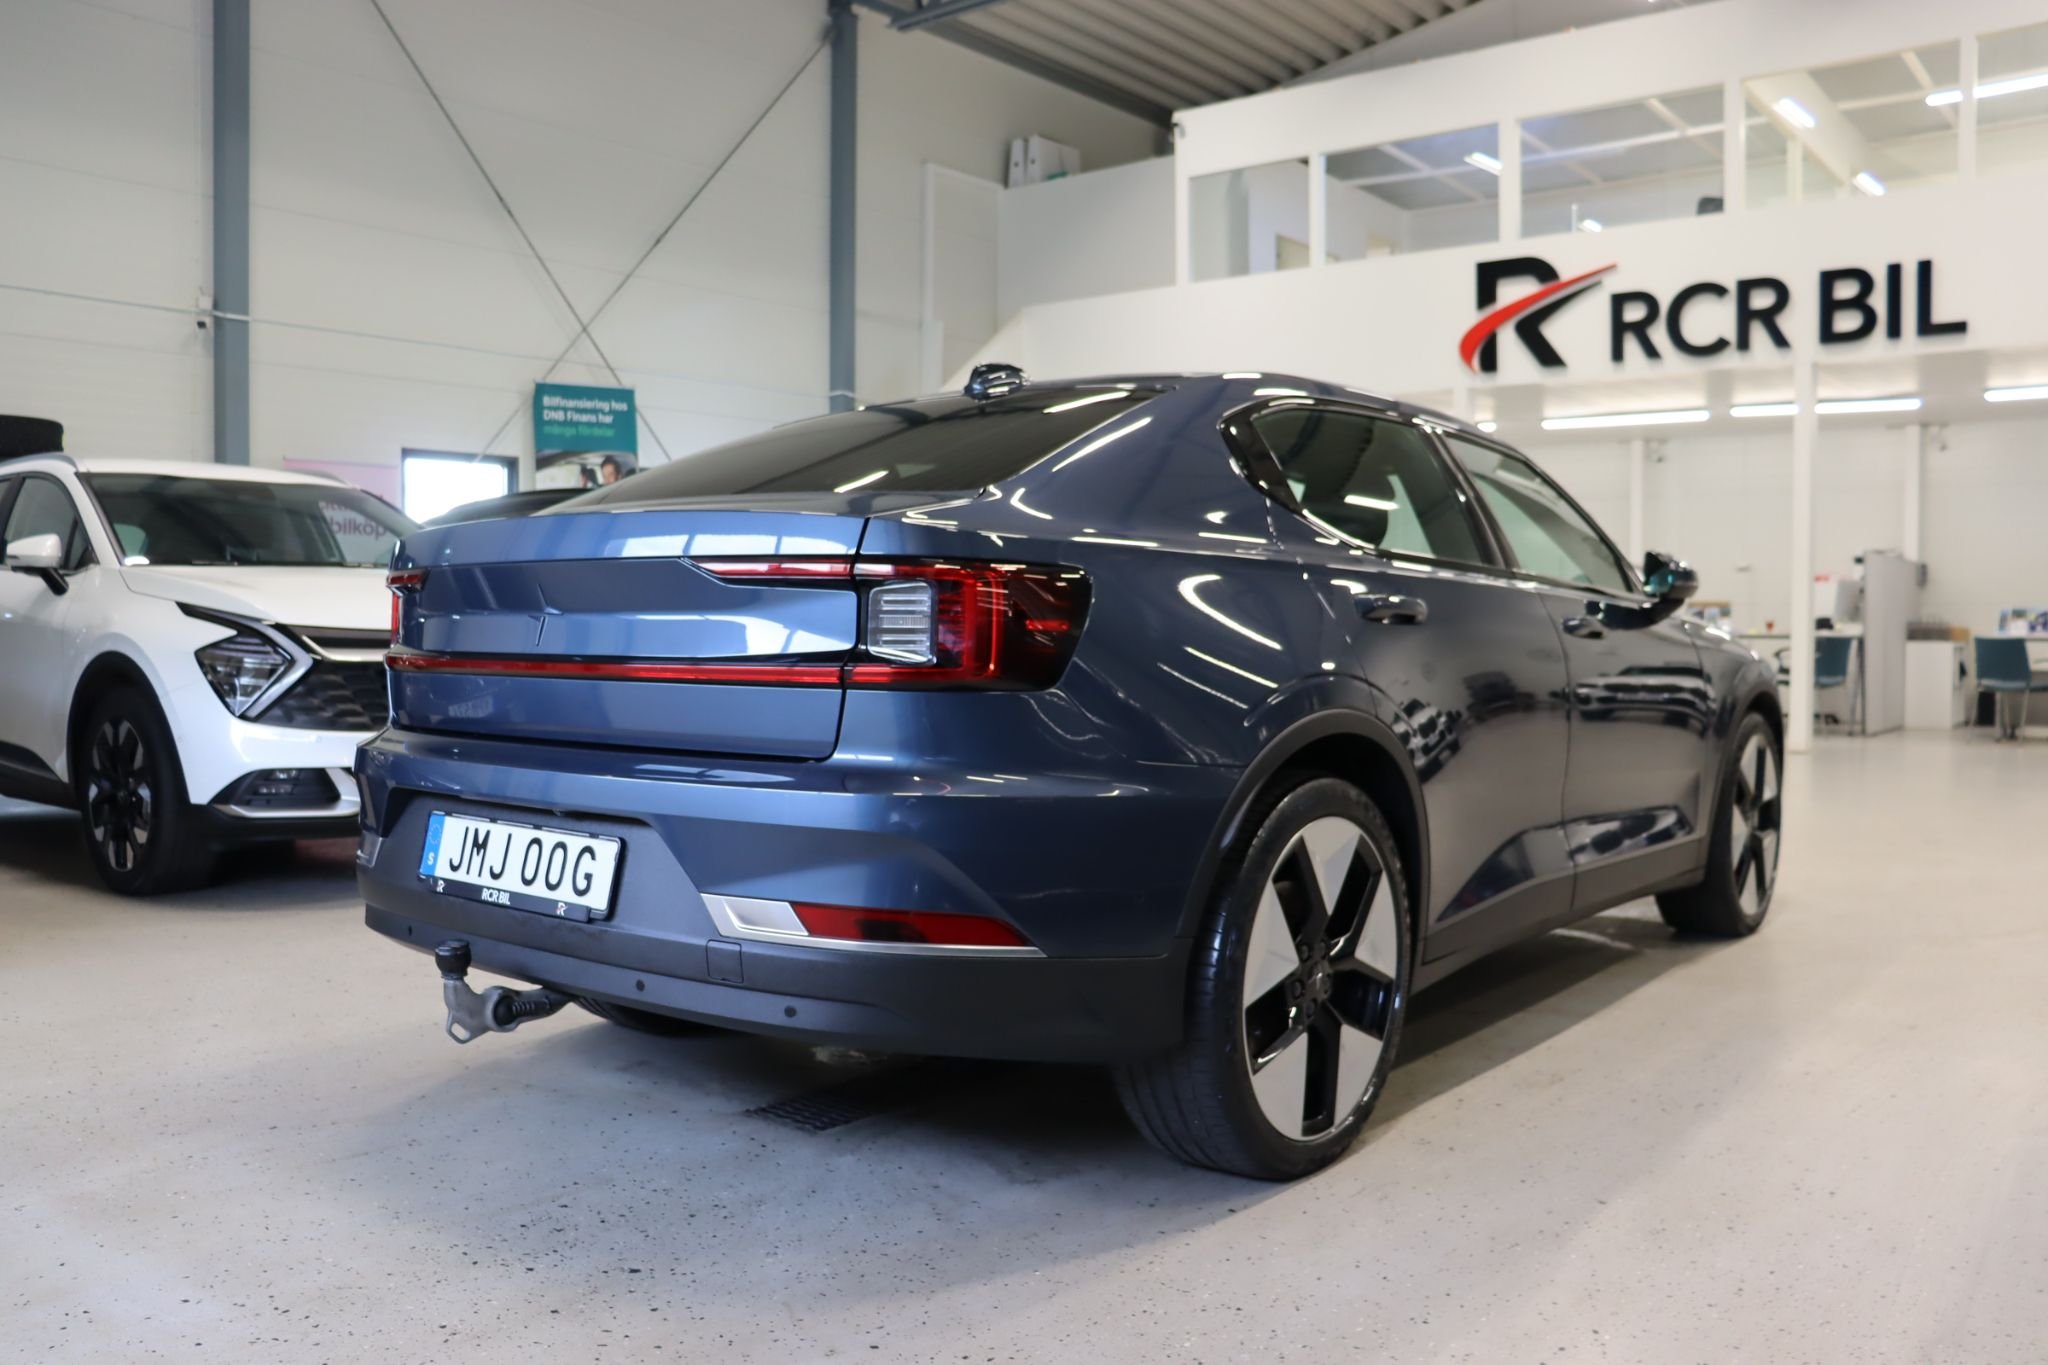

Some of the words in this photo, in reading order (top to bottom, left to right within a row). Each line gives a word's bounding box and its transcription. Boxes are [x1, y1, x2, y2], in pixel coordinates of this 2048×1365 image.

[1610, 277, 1792, 363] RCR
[1818, 259, 1968, 345] BIL
[543, 395, 610, 413] Bilfinansiering
[611, 400, 628, 412] hos
[543, 409, 565, 422] DNB
[567, 410, 597, 423] Finans
[598, 412, 614, 424] har
[427, 852, 435, 865] S
[449, 826, 512, 880] JMJ
[481, 887, 499, 903] RCR
[499, 892, 511, 905] BIL
